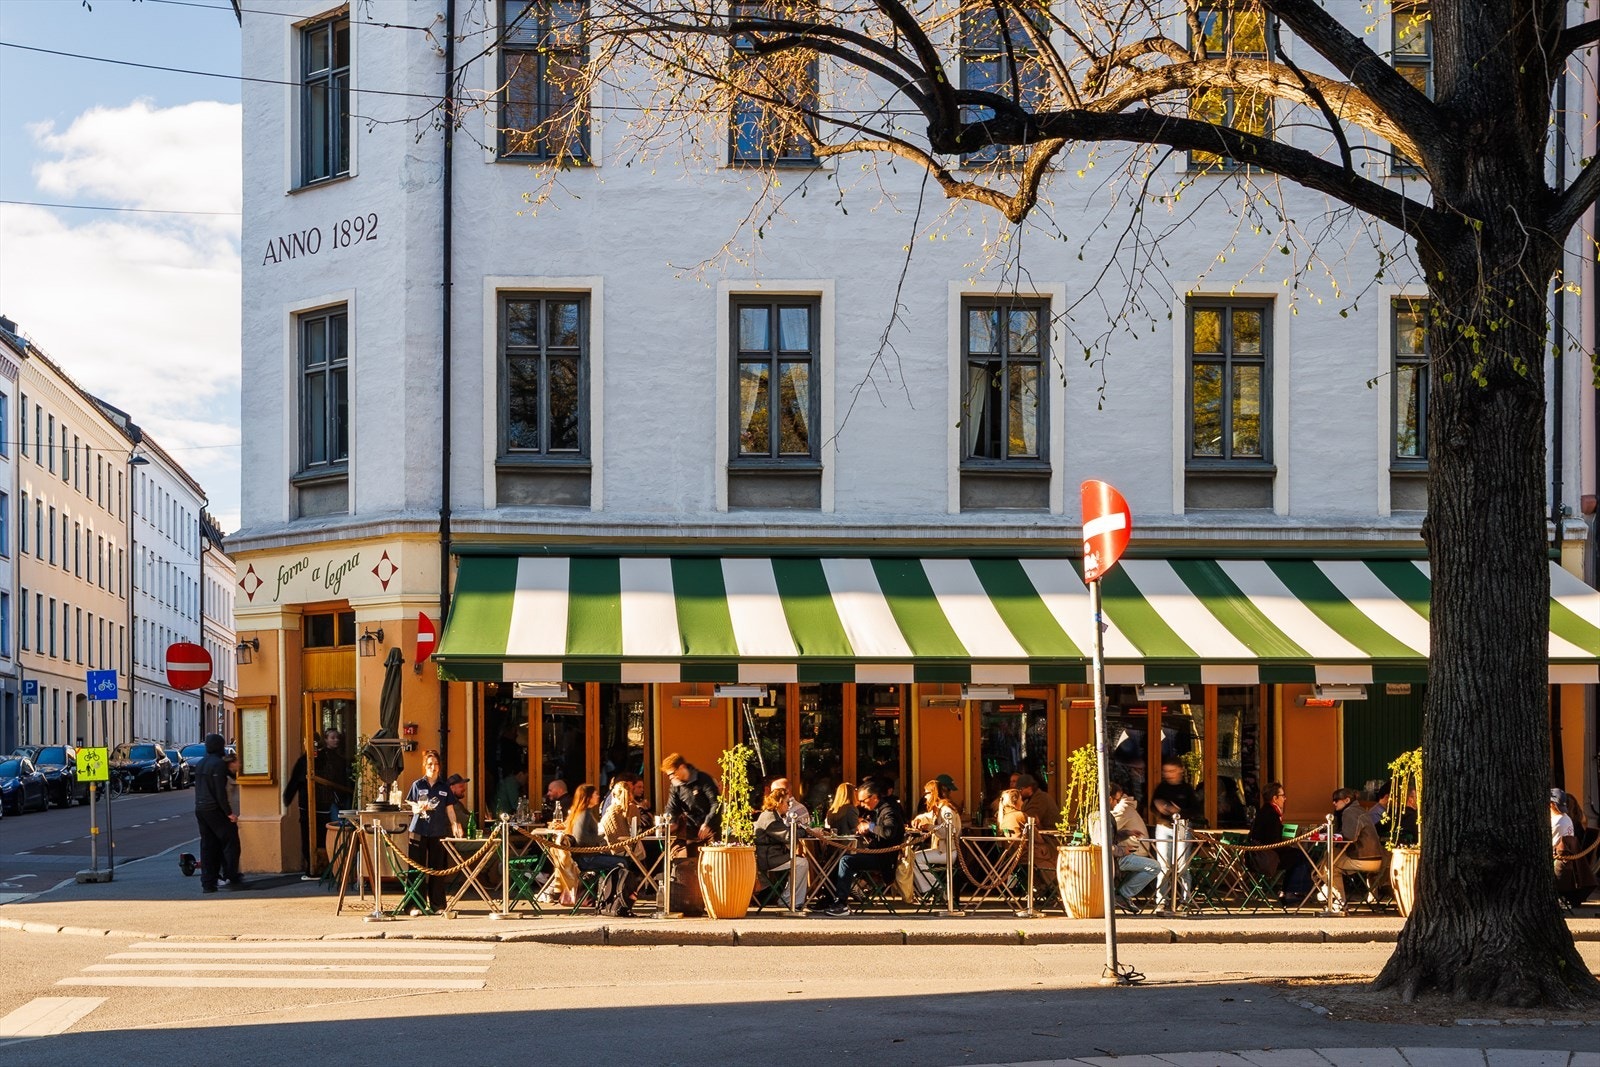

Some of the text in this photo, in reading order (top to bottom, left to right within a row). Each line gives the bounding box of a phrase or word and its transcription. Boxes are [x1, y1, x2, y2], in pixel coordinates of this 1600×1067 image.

[262, 212, 378, 266] ANNO 1892
[273, 552, 361, 602] forno a legna
[26, 682, 34, 694] P
